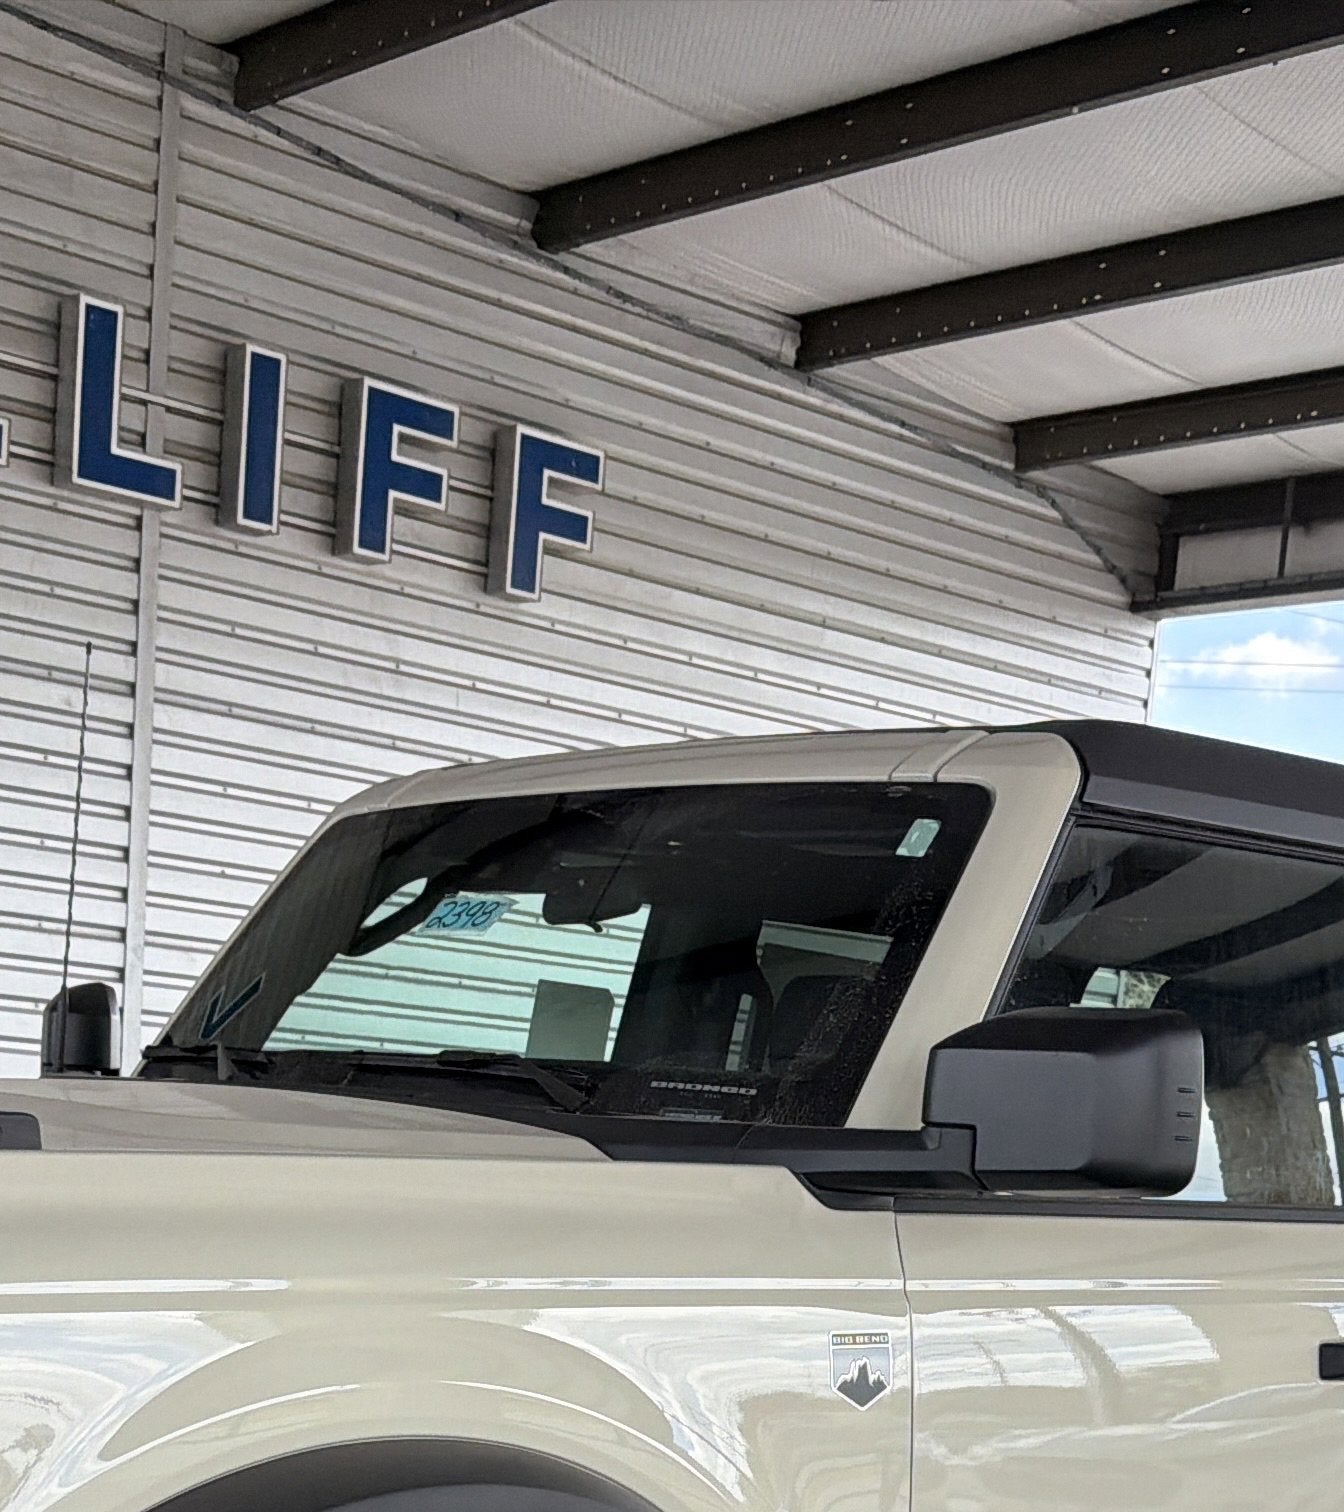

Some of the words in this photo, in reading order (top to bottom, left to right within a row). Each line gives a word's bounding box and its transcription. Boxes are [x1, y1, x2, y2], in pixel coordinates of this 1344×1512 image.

[425, 900, 501, 929] 2398
[833, 1335, 854, 1344] BIG
[855, 1334, 889, 1344] BEND
